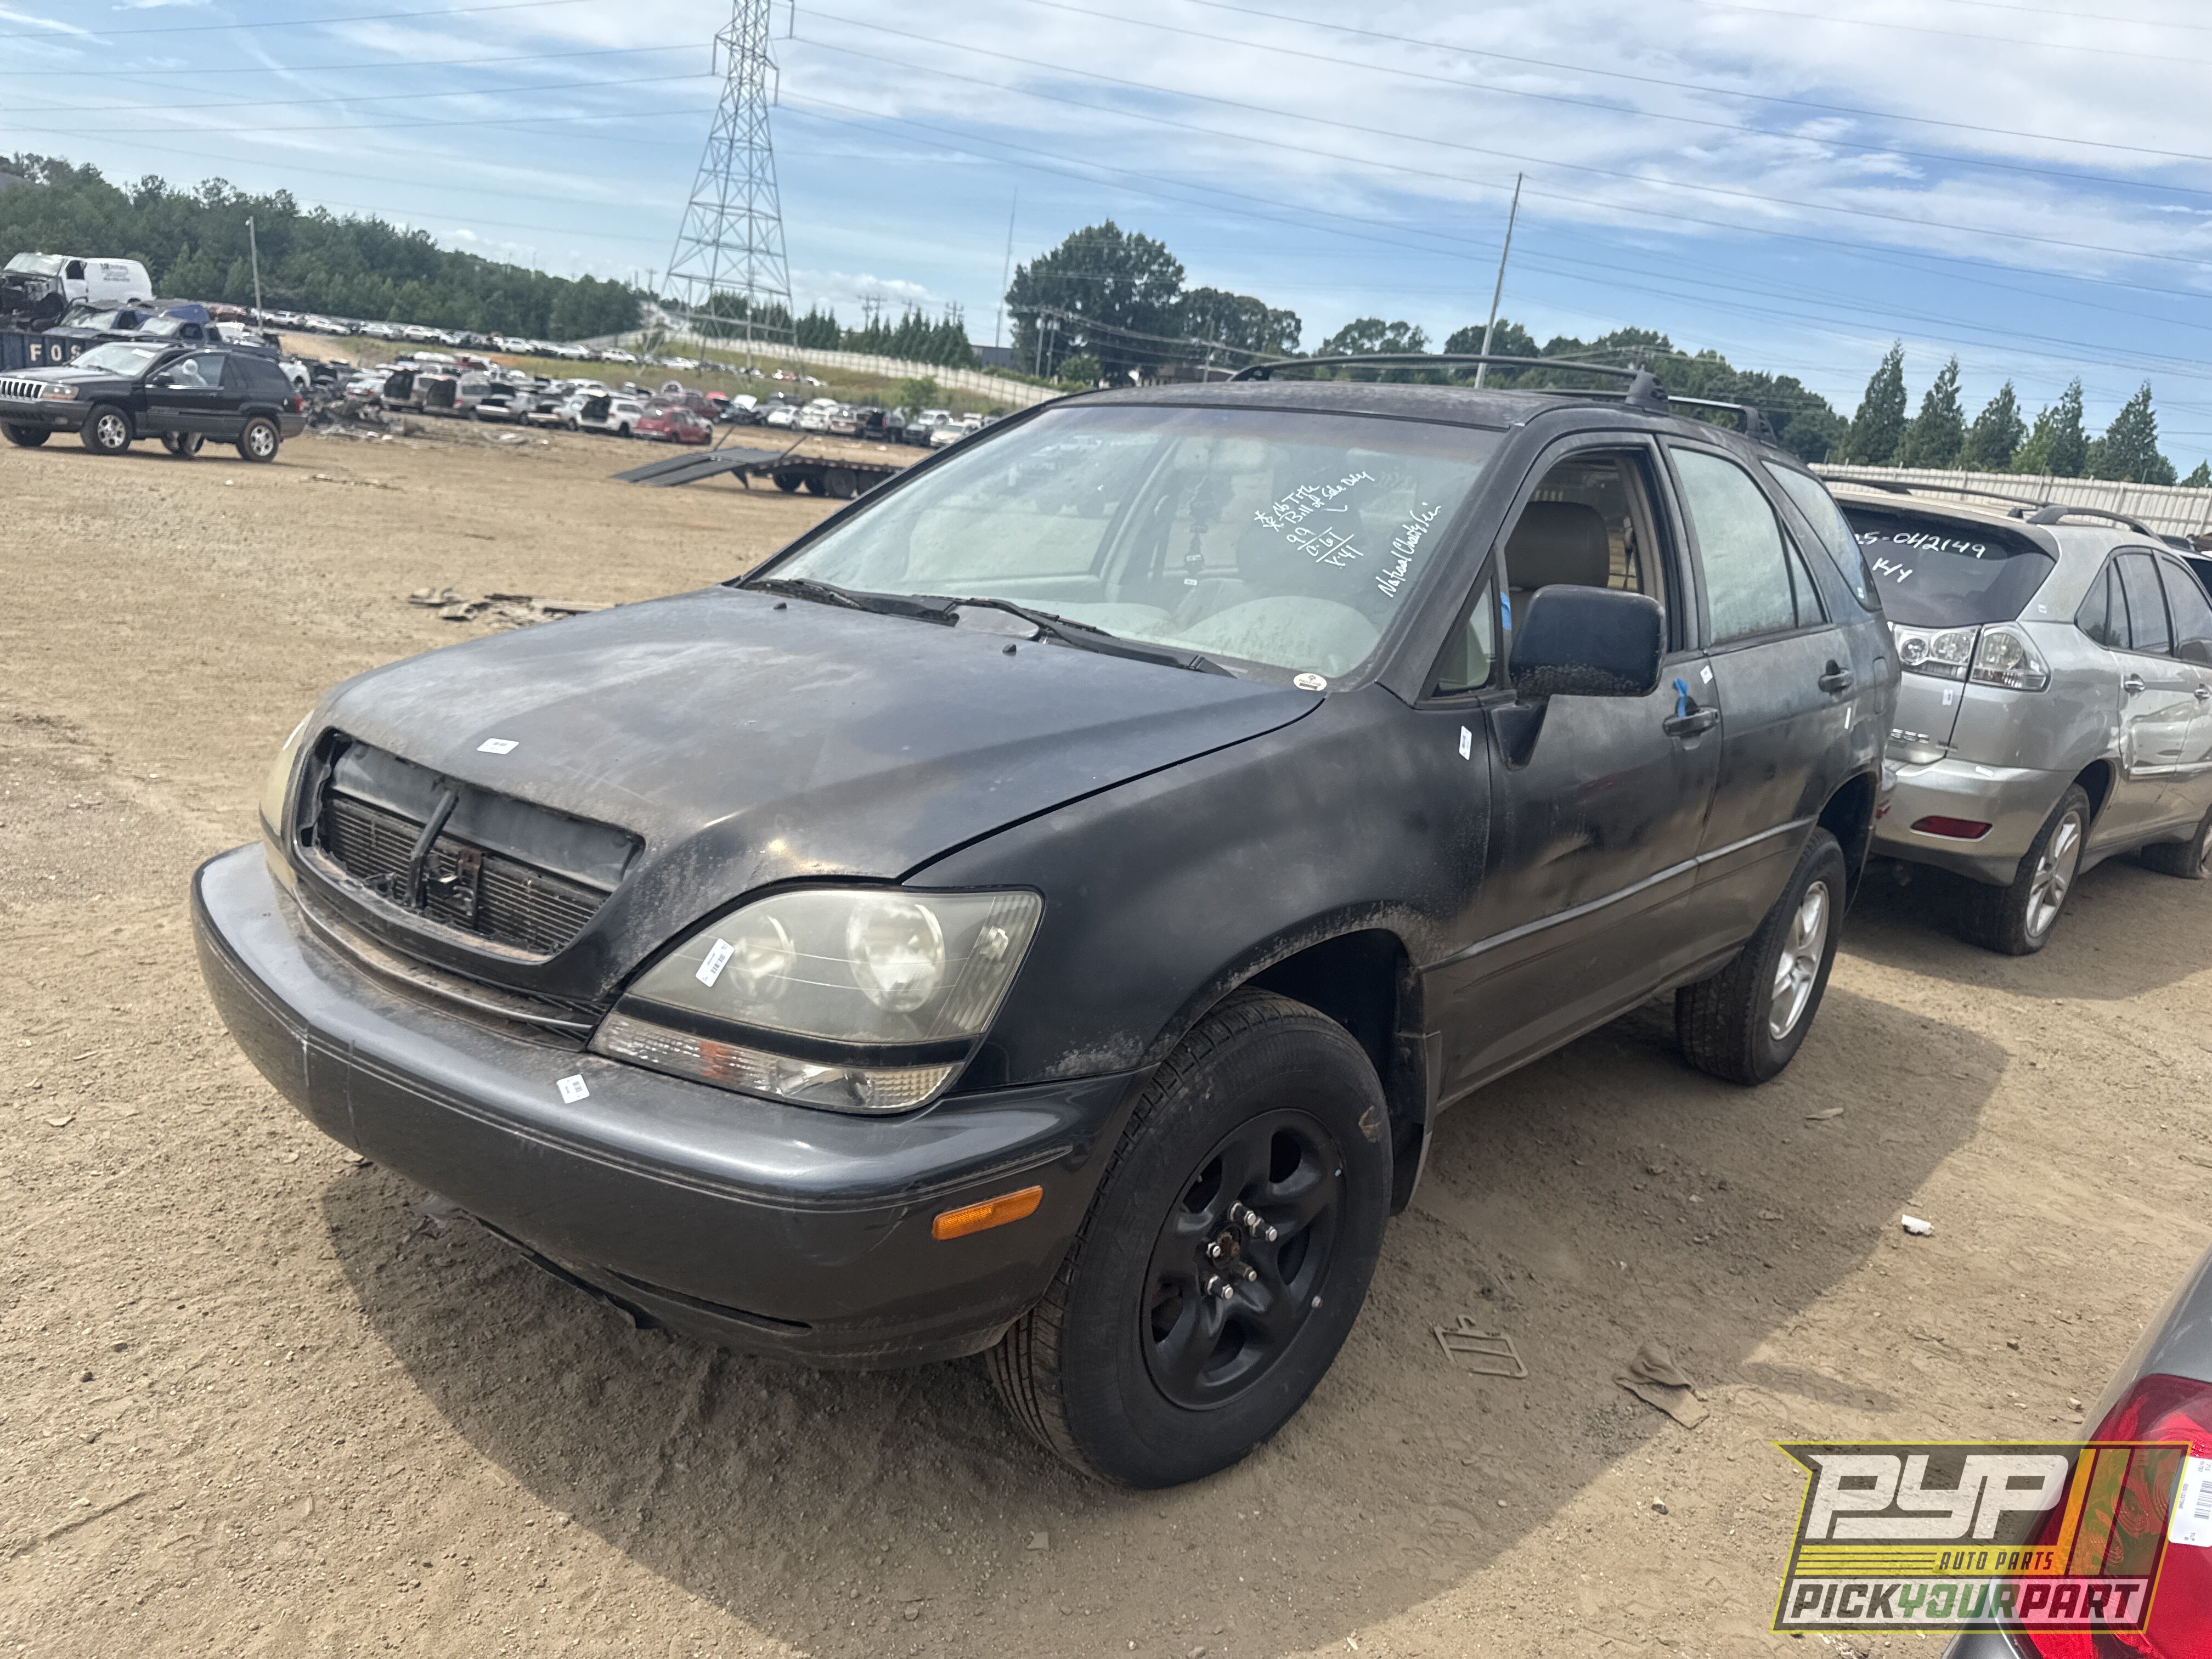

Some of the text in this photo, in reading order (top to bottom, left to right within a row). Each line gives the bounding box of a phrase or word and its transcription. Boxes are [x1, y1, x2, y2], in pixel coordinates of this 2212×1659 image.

[1273, 501, 1290, 517] No
[1279, 503, 1314, 524] Bill
[1286, 527, 1317, 544] 99
